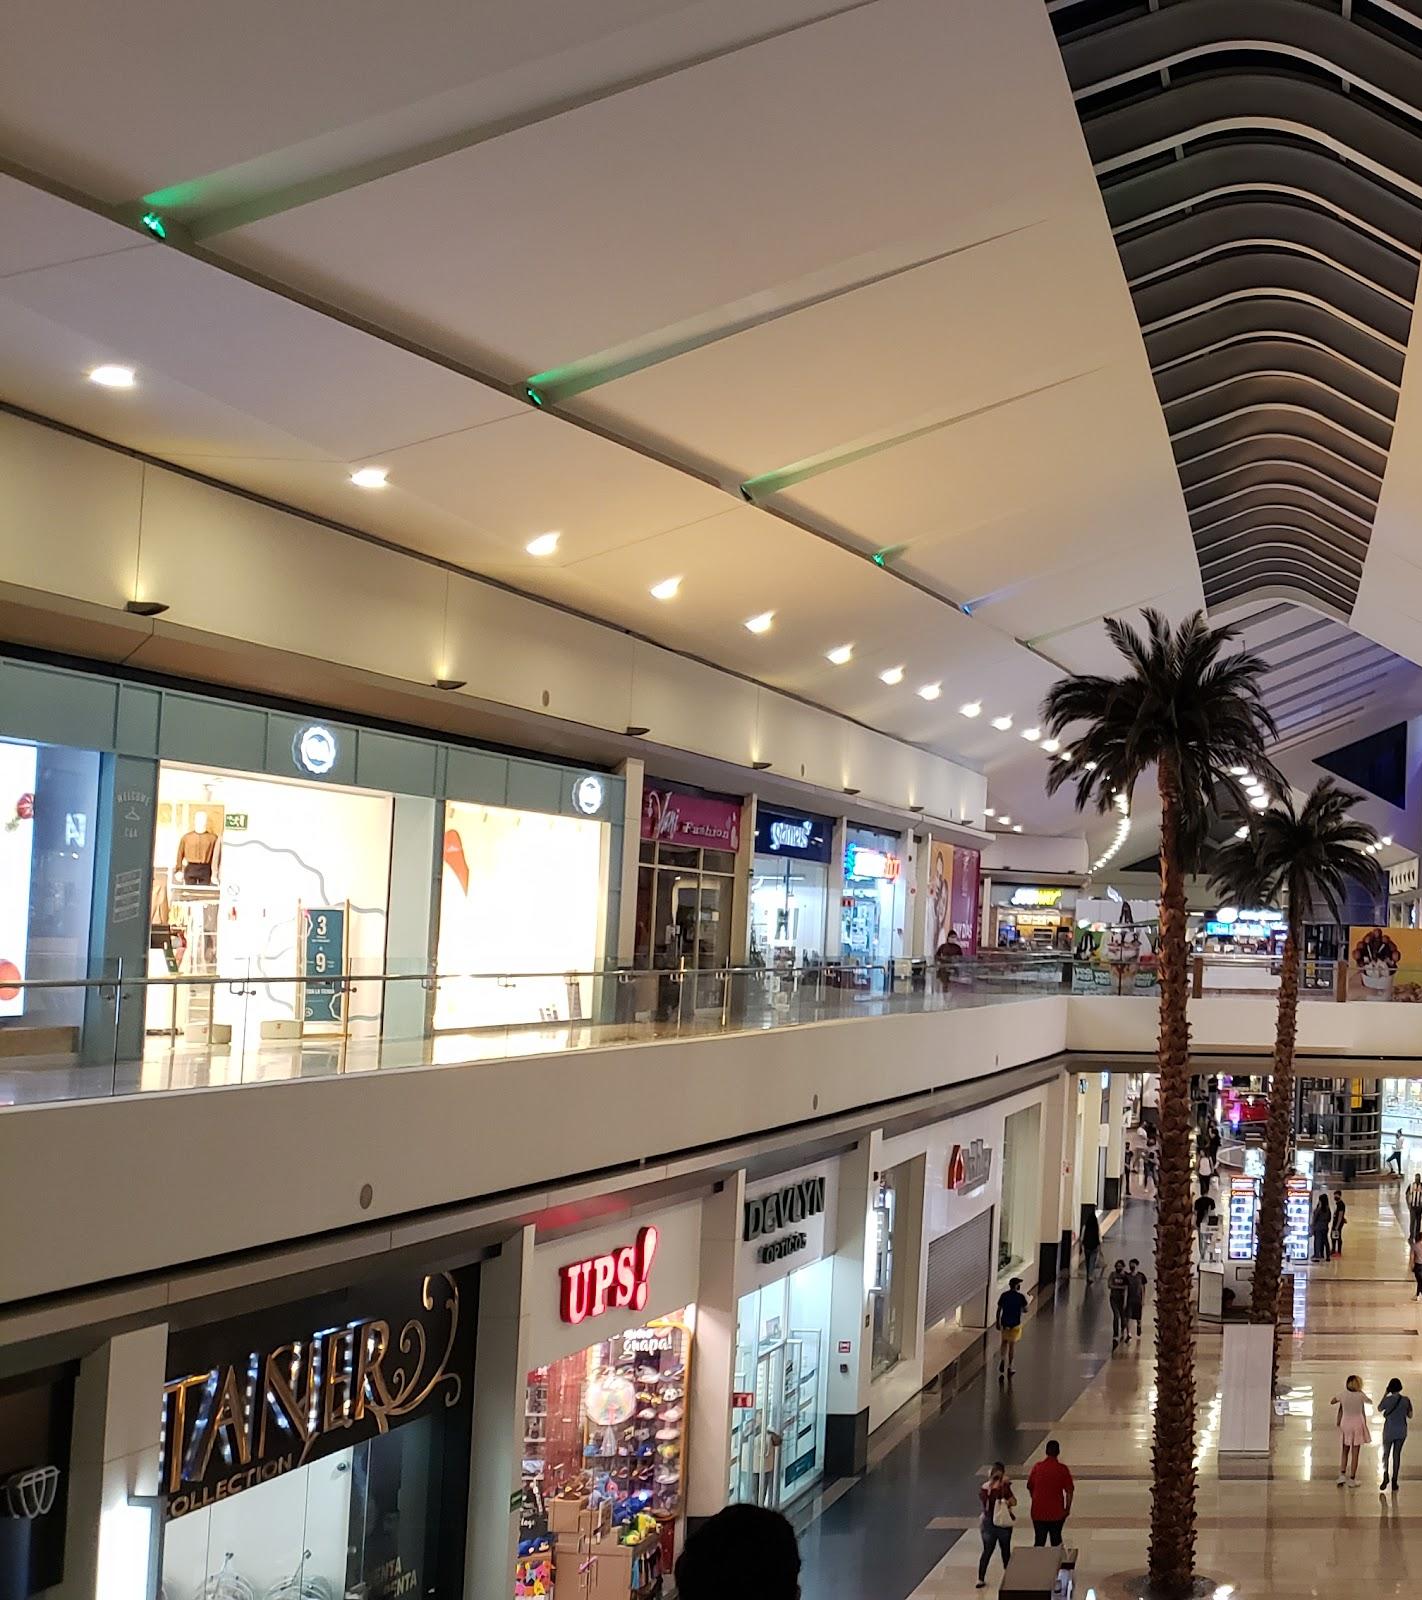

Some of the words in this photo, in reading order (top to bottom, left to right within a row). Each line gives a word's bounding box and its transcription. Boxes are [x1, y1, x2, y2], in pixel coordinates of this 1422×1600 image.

[682, 820, 730, 840] Fashion
[316, 915, 327, 935] 3
[315, 952, 326, 973] 9
[559, 1226, 658, 1324] UPS!
[619, 1338, 673, 1361] guapa!
